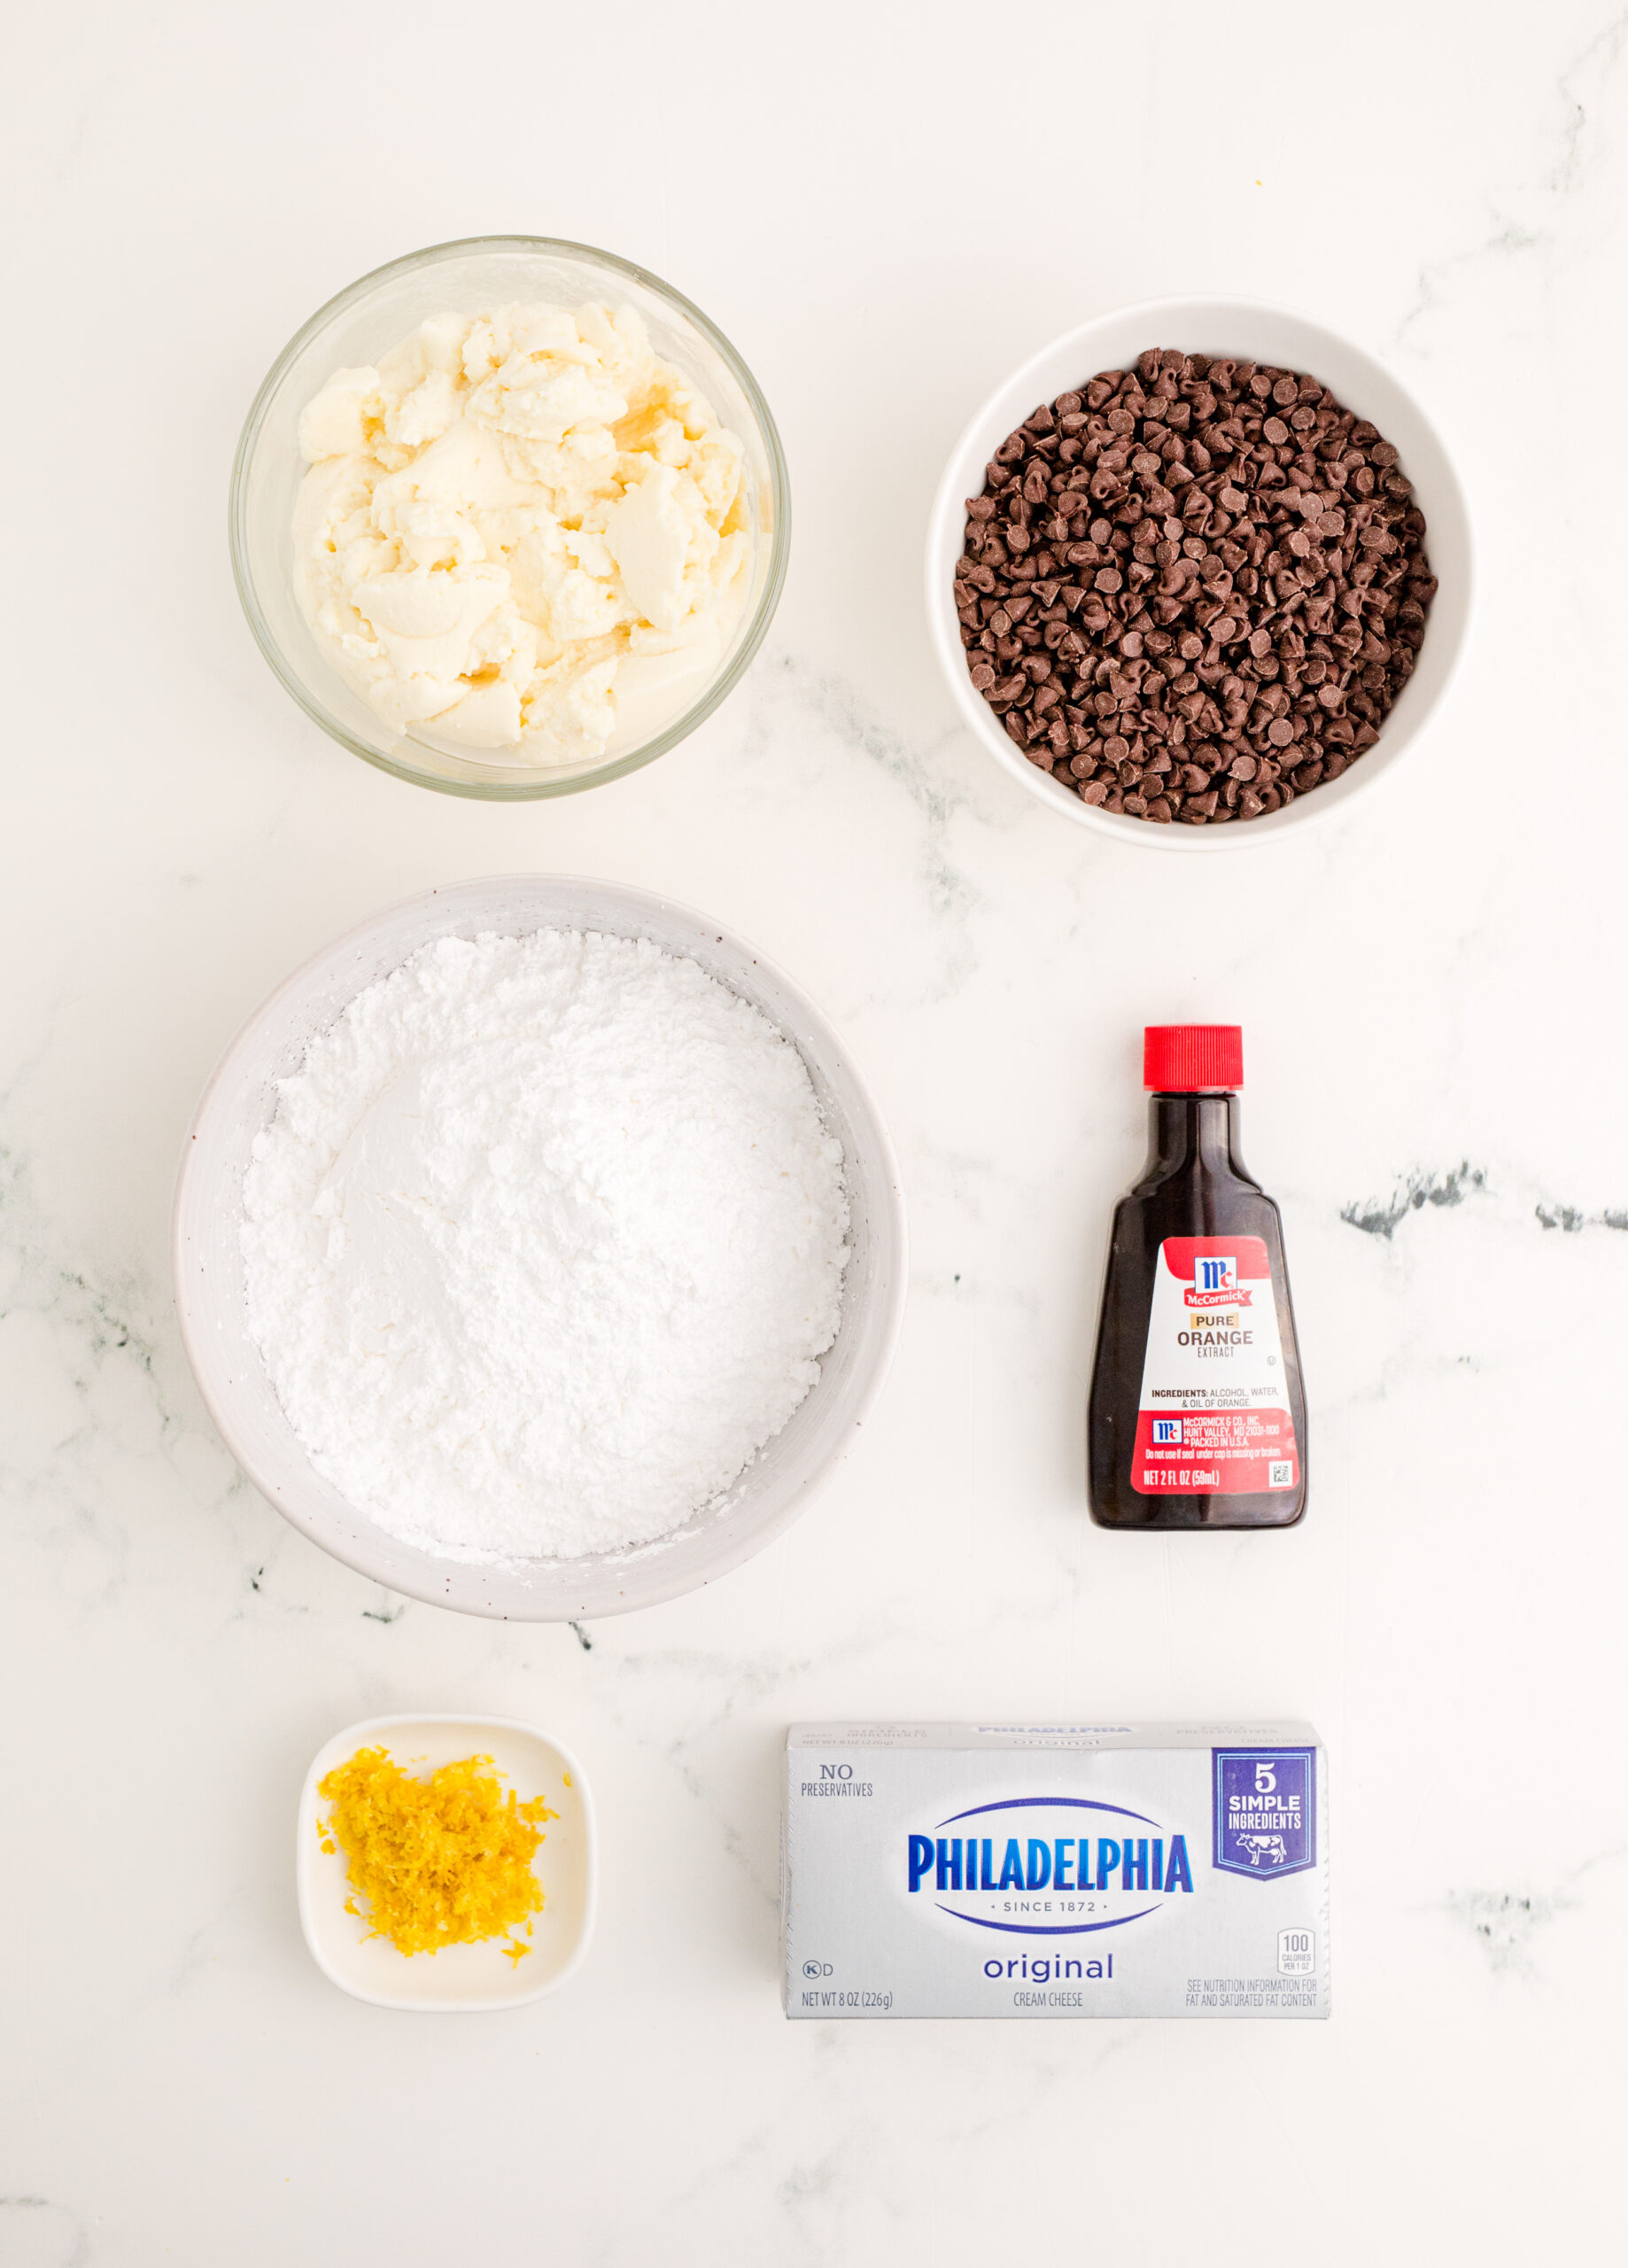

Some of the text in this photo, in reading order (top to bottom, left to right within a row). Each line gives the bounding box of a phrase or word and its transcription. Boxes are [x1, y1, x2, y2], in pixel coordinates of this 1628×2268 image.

[1187, 1290, 1244, 1306] McCormick
[1196, 1316, 1234, 1326] PURE
[1177, 1331, 1253, 1346] ORANGE
[1198, 1347, 1235, 1358] EXTRACT
[1151, 1386, 1279, 1398] INGREDIENTS: ALCOHOL, WATER,
[1182, 1399, 1188, 1408] &
[1190, 1399, 1203, 1408] OIL
[1205, 1399, 1215, 1408] OF
[1226, 1417, 1231, 1426] &
[1247, 1415, 1260, 1426] INC.
[1183, 1427, 1202, 1438] HUNT
[1203, 1426, 1231, 1438] VALLEY,
[1233, 1425, 1244, 1436] MD
[1190, 1437, 1219, 1448] PACKED
[1221, 1437, 1228, 1447] IN
[1145, 1449, 1154, 1459] Do
[1154, 1449, 1165, 1459] not
[1165, 1449, 1176, 1459] use
[1182, 1448, 1195, 1459] seal
[1196, 1448, 1213, 1459] under
[1214, 1449, 1225, 1460] cap
[1226, 1448, 1231, 1458] is
[1232, 1447, 1254, 1460] missing
[1254, 1449, 1261, 1458] or
[1143, 1469, 1220, 1487] NET 2 FL OZ (59mL)
[819, 1764, 853, 1780] NO
[1255, 1762, 1276, 1793] 5
[801, 1783, 872, 1797] PRESERVATIVES
[1229, 1795, 1300, 1812] SIMPLE
[1229, 1813, 1301, 1829] INGREDIENTS
[908, 1834, 1194, 1892] PHILADELPHIA
[1004, 1902, 1096, 1912] SINCE 1872
[1283, 1934, 1309, 1952] 100
[983, 1953, 1113, 1984] original
[1187, 1978, 1316, 1992] SEE NUTRITION INFORMATION FOR
[802, 1991, 893, 2009] NET WT 8 OZ (226g)
[1013, 1992, 1083, 2007] CREAM CHEESE
[1186, 1993, 1317, 2007] FAT AND SATURATED FAT CONTENT
